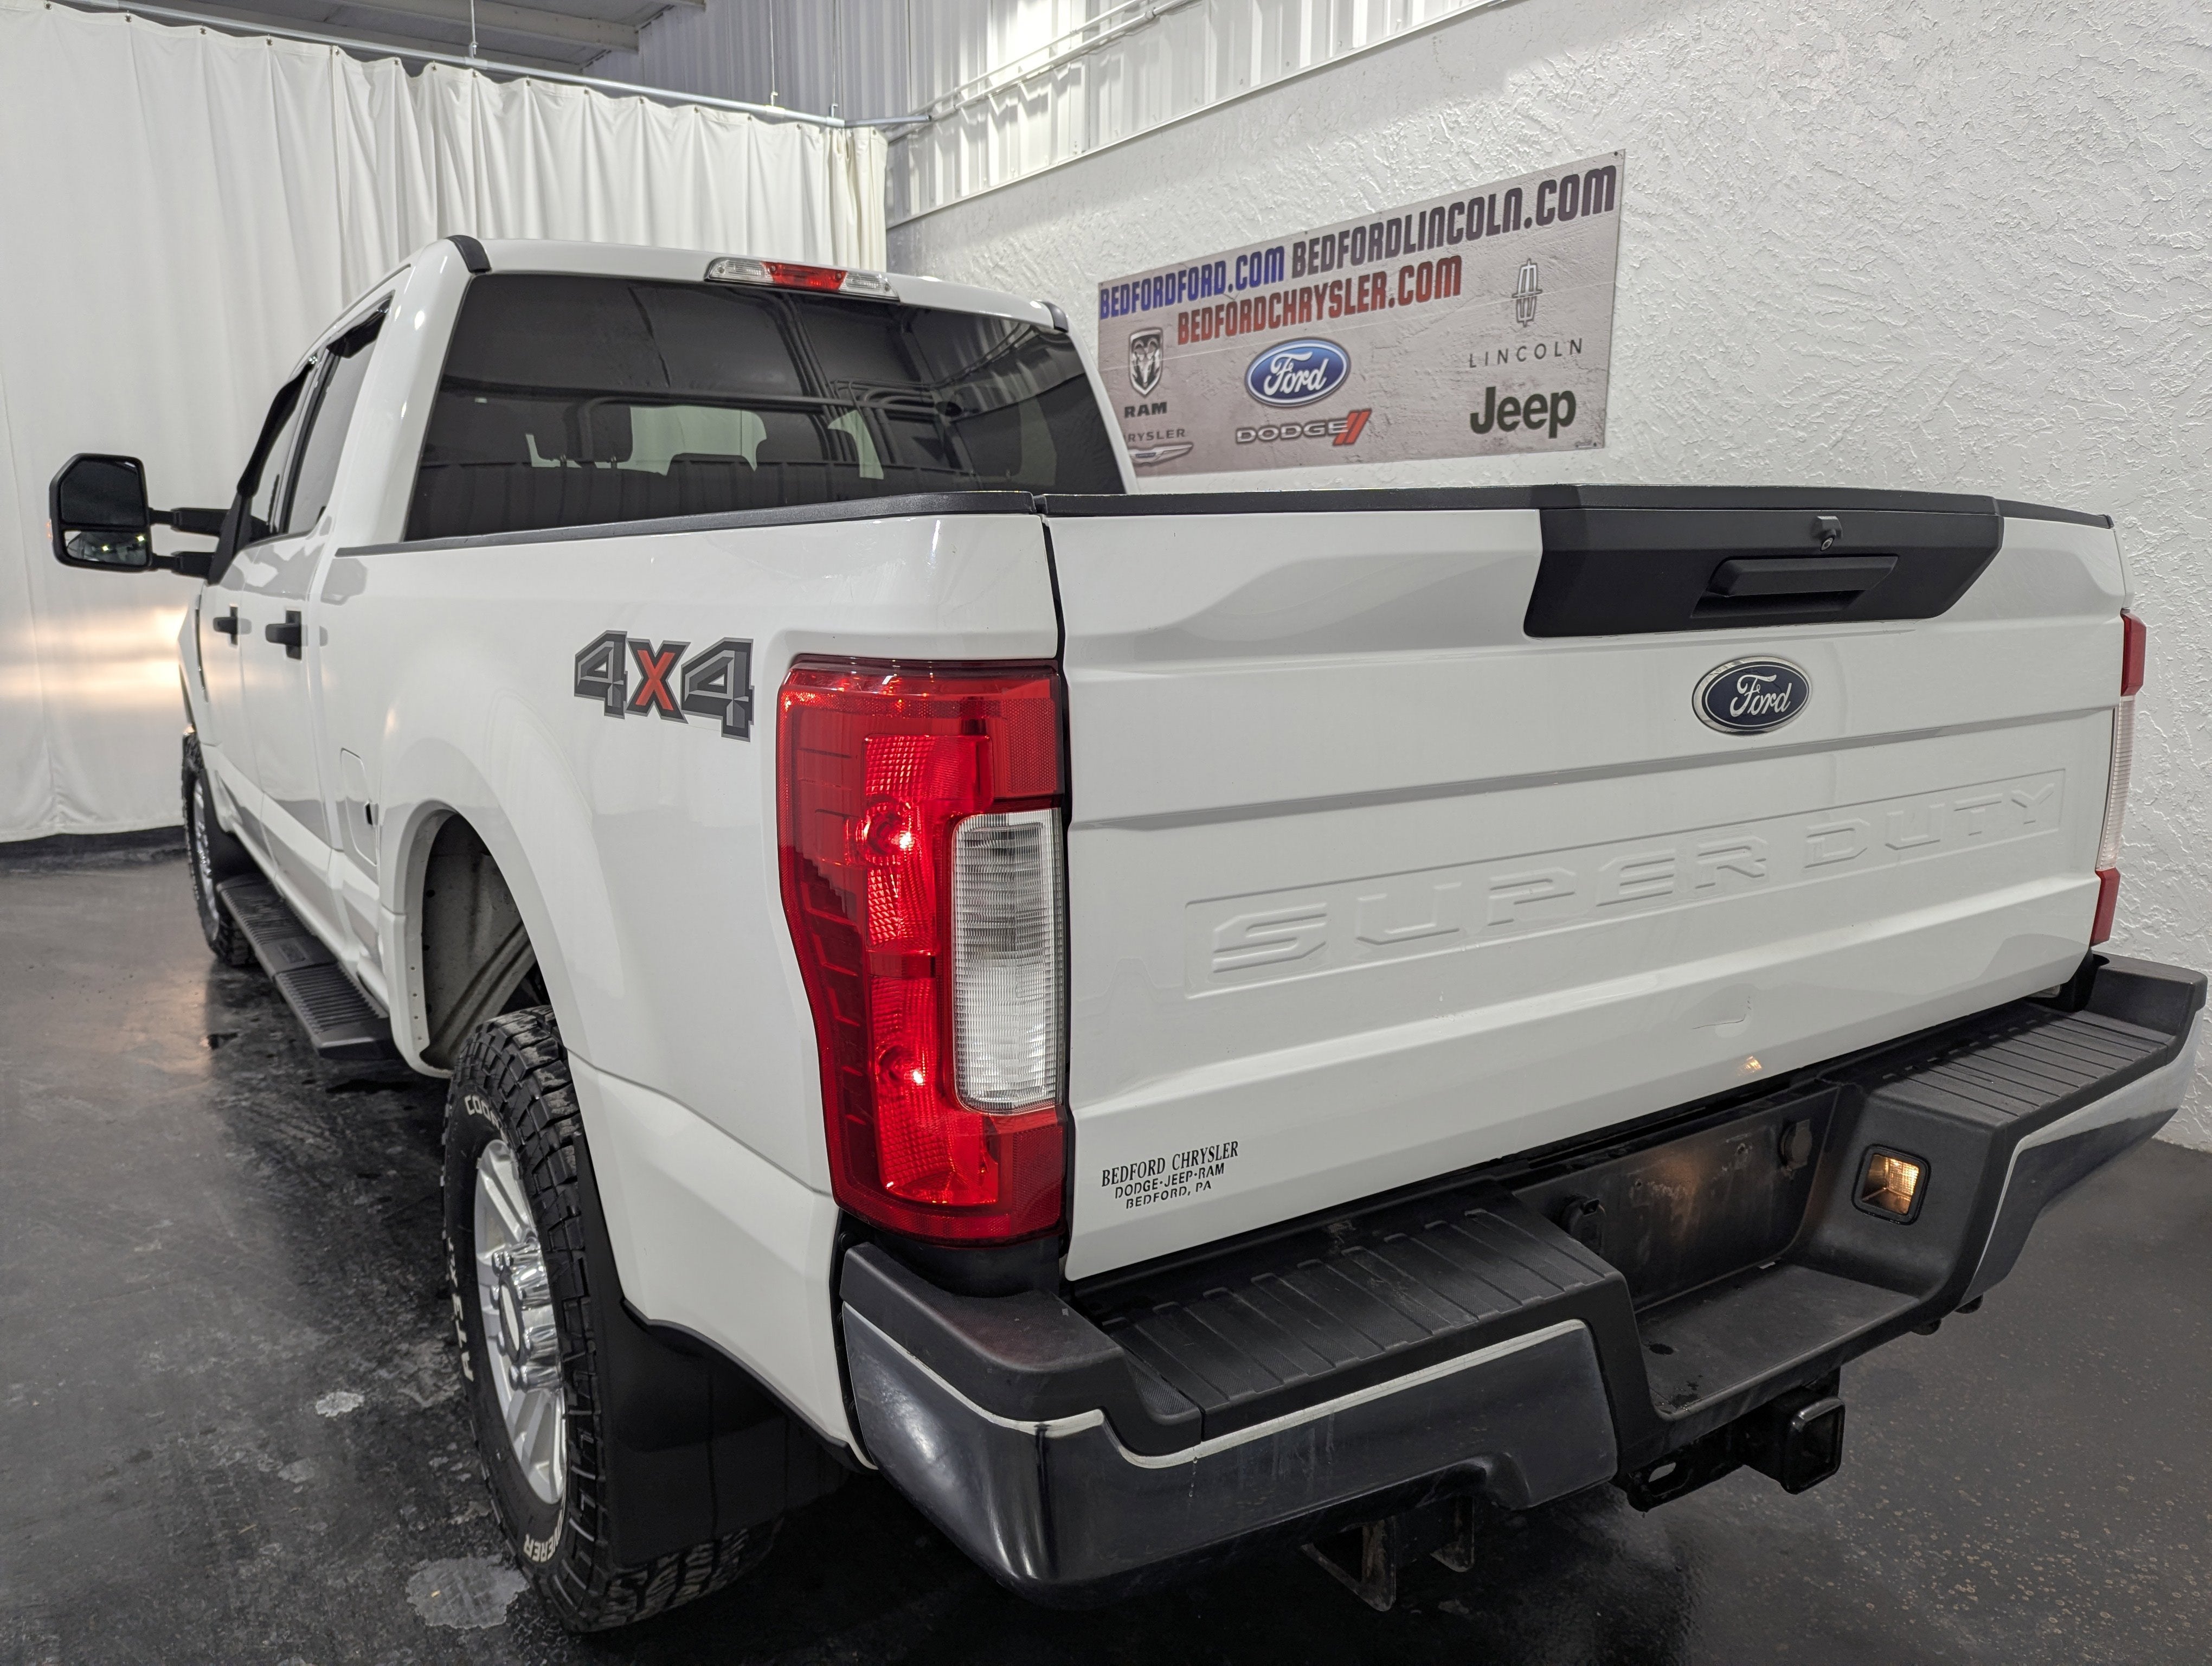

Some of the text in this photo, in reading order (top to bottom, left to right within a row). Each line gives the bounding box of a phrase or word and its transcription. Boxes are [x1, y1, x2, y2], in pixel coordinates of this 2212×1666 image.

[1100, 165, 1617, 320] BEDFORDFORD.COM BEDFORDLINCOLN.COM
[1178, 255, 1462, 345] BEDFORDCHRYSLER.COM
[1264, 351, 1329, 395] Ford
[1469, 338, 1582, 368] LINCOLN
[1124, 401, 1167, 418] RAM
[1237, 419, 1348, 443] DODGE
[1470, 386, 1577, 439] Jeep
[1124, 428, 1186, 443] RYSLER
[1730, 674, 1792, 717] Ford
[1213, 783, 2055, 973] SUPER DUTY
[1102, 1140, 1239, 1187] BEDFORD CHRYSLER
[1126, 1180, 1212, 1209] BEDFORD, PA
